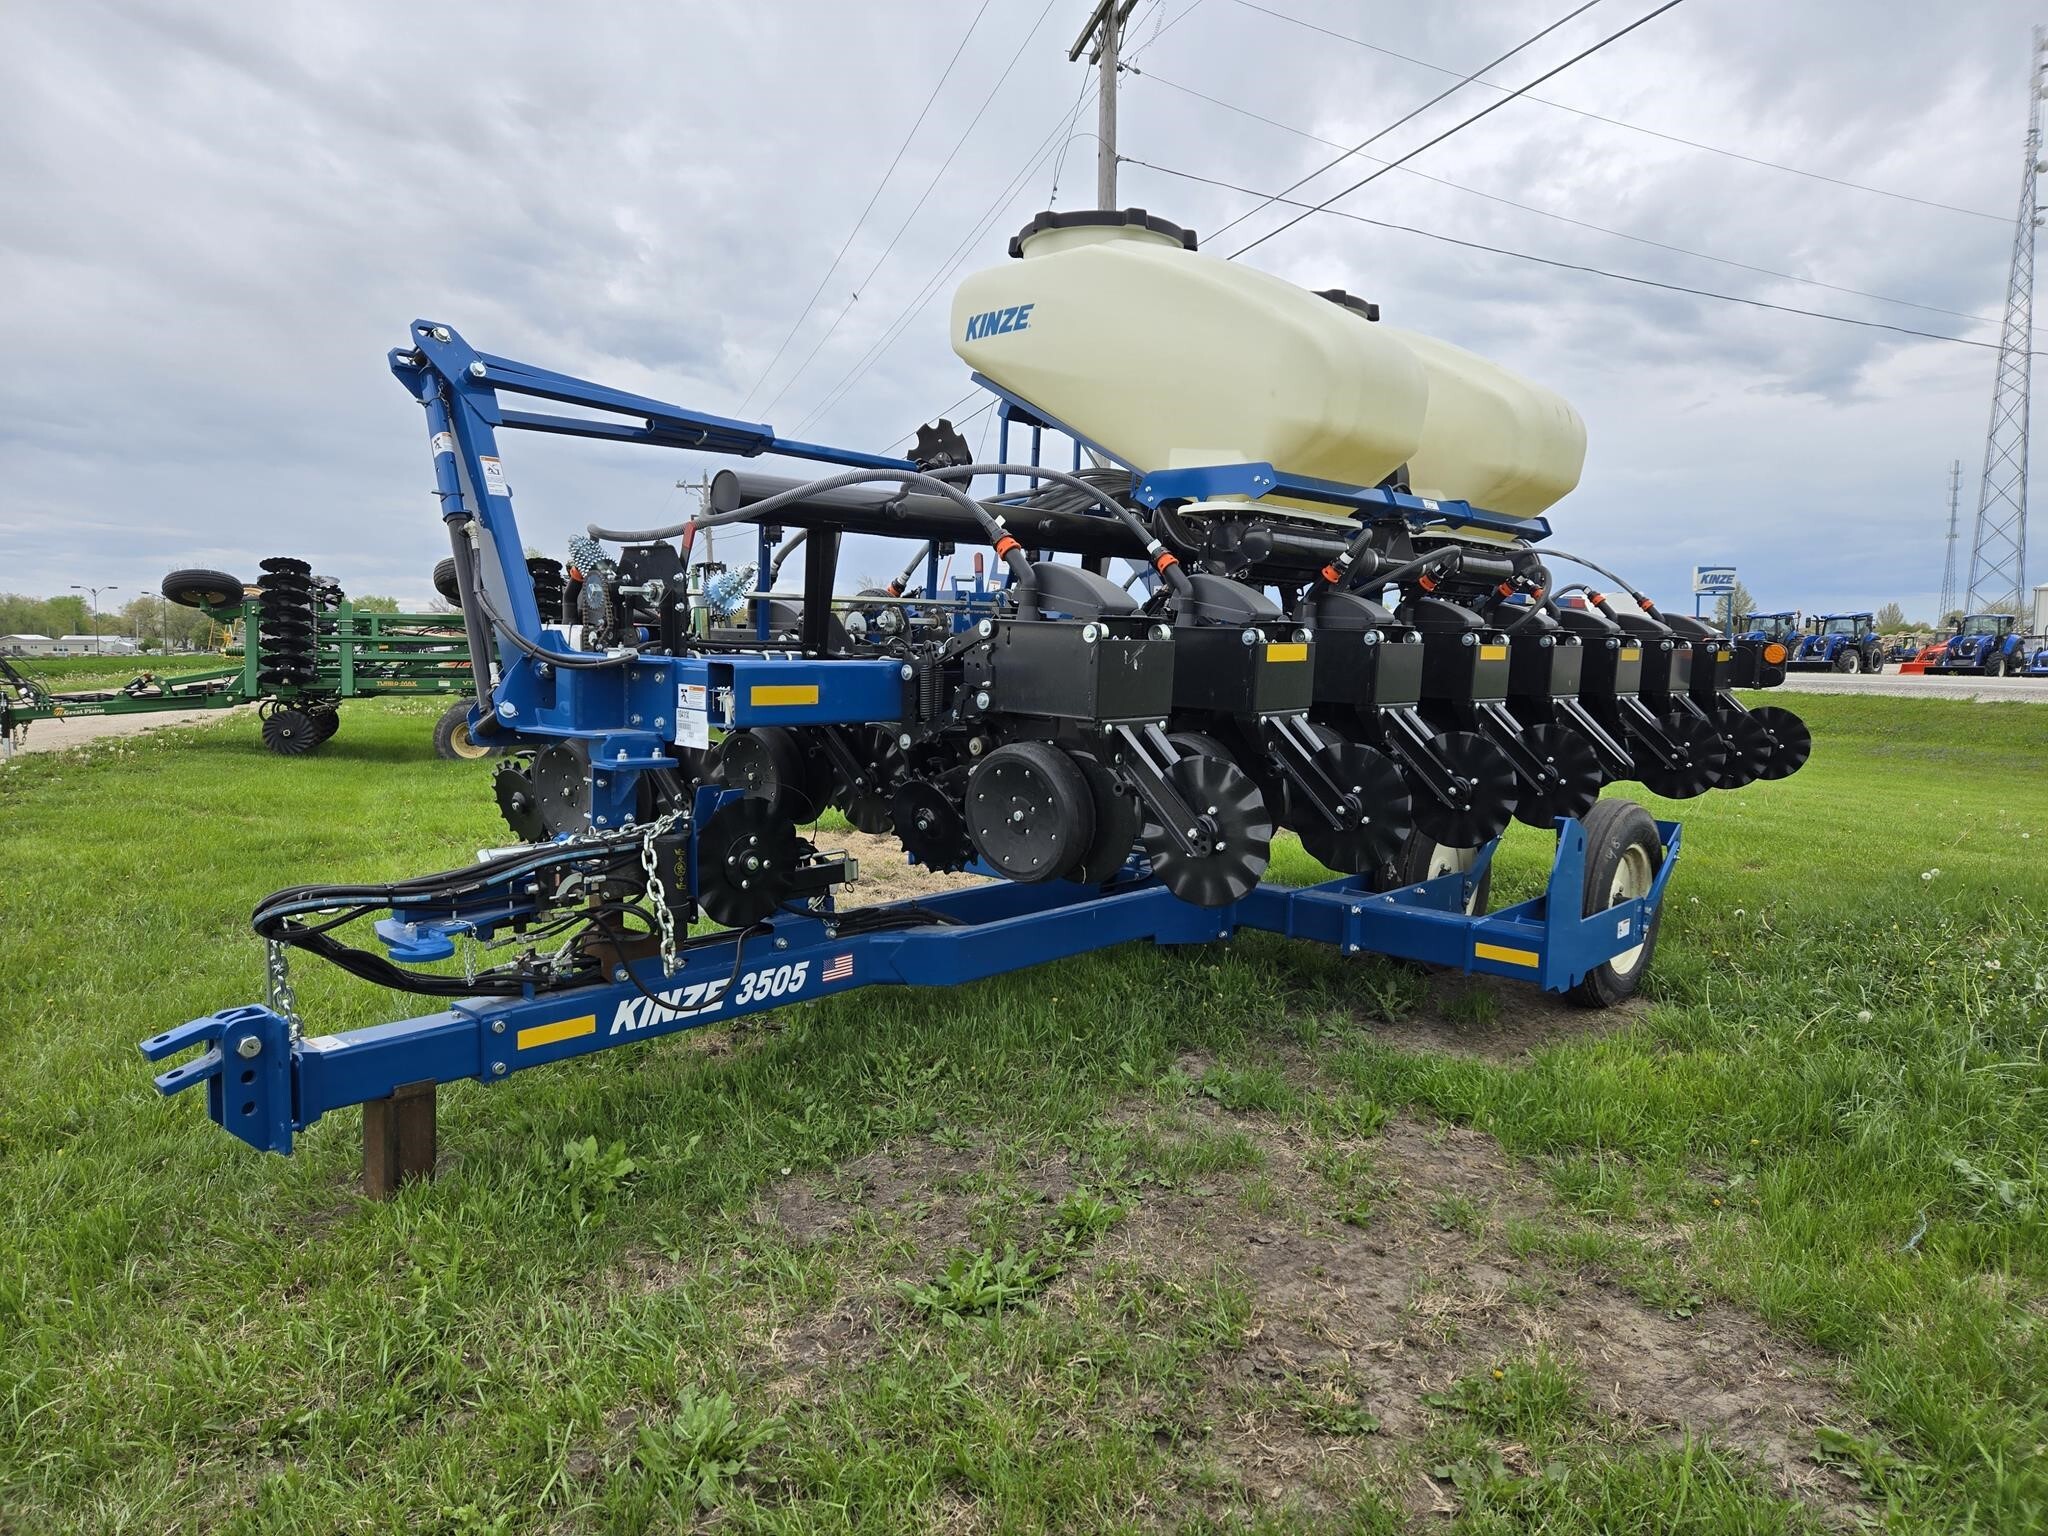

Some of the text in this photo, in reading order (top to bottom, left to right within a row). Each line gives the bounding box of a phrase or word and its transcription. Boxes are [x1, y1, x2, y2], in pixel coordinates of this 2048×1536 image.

[965, 303, 1036, 342] KINZE
[1700, 574, 1735, 585] KINZE
[609, 960, 810, 1036] KINZE 3505
